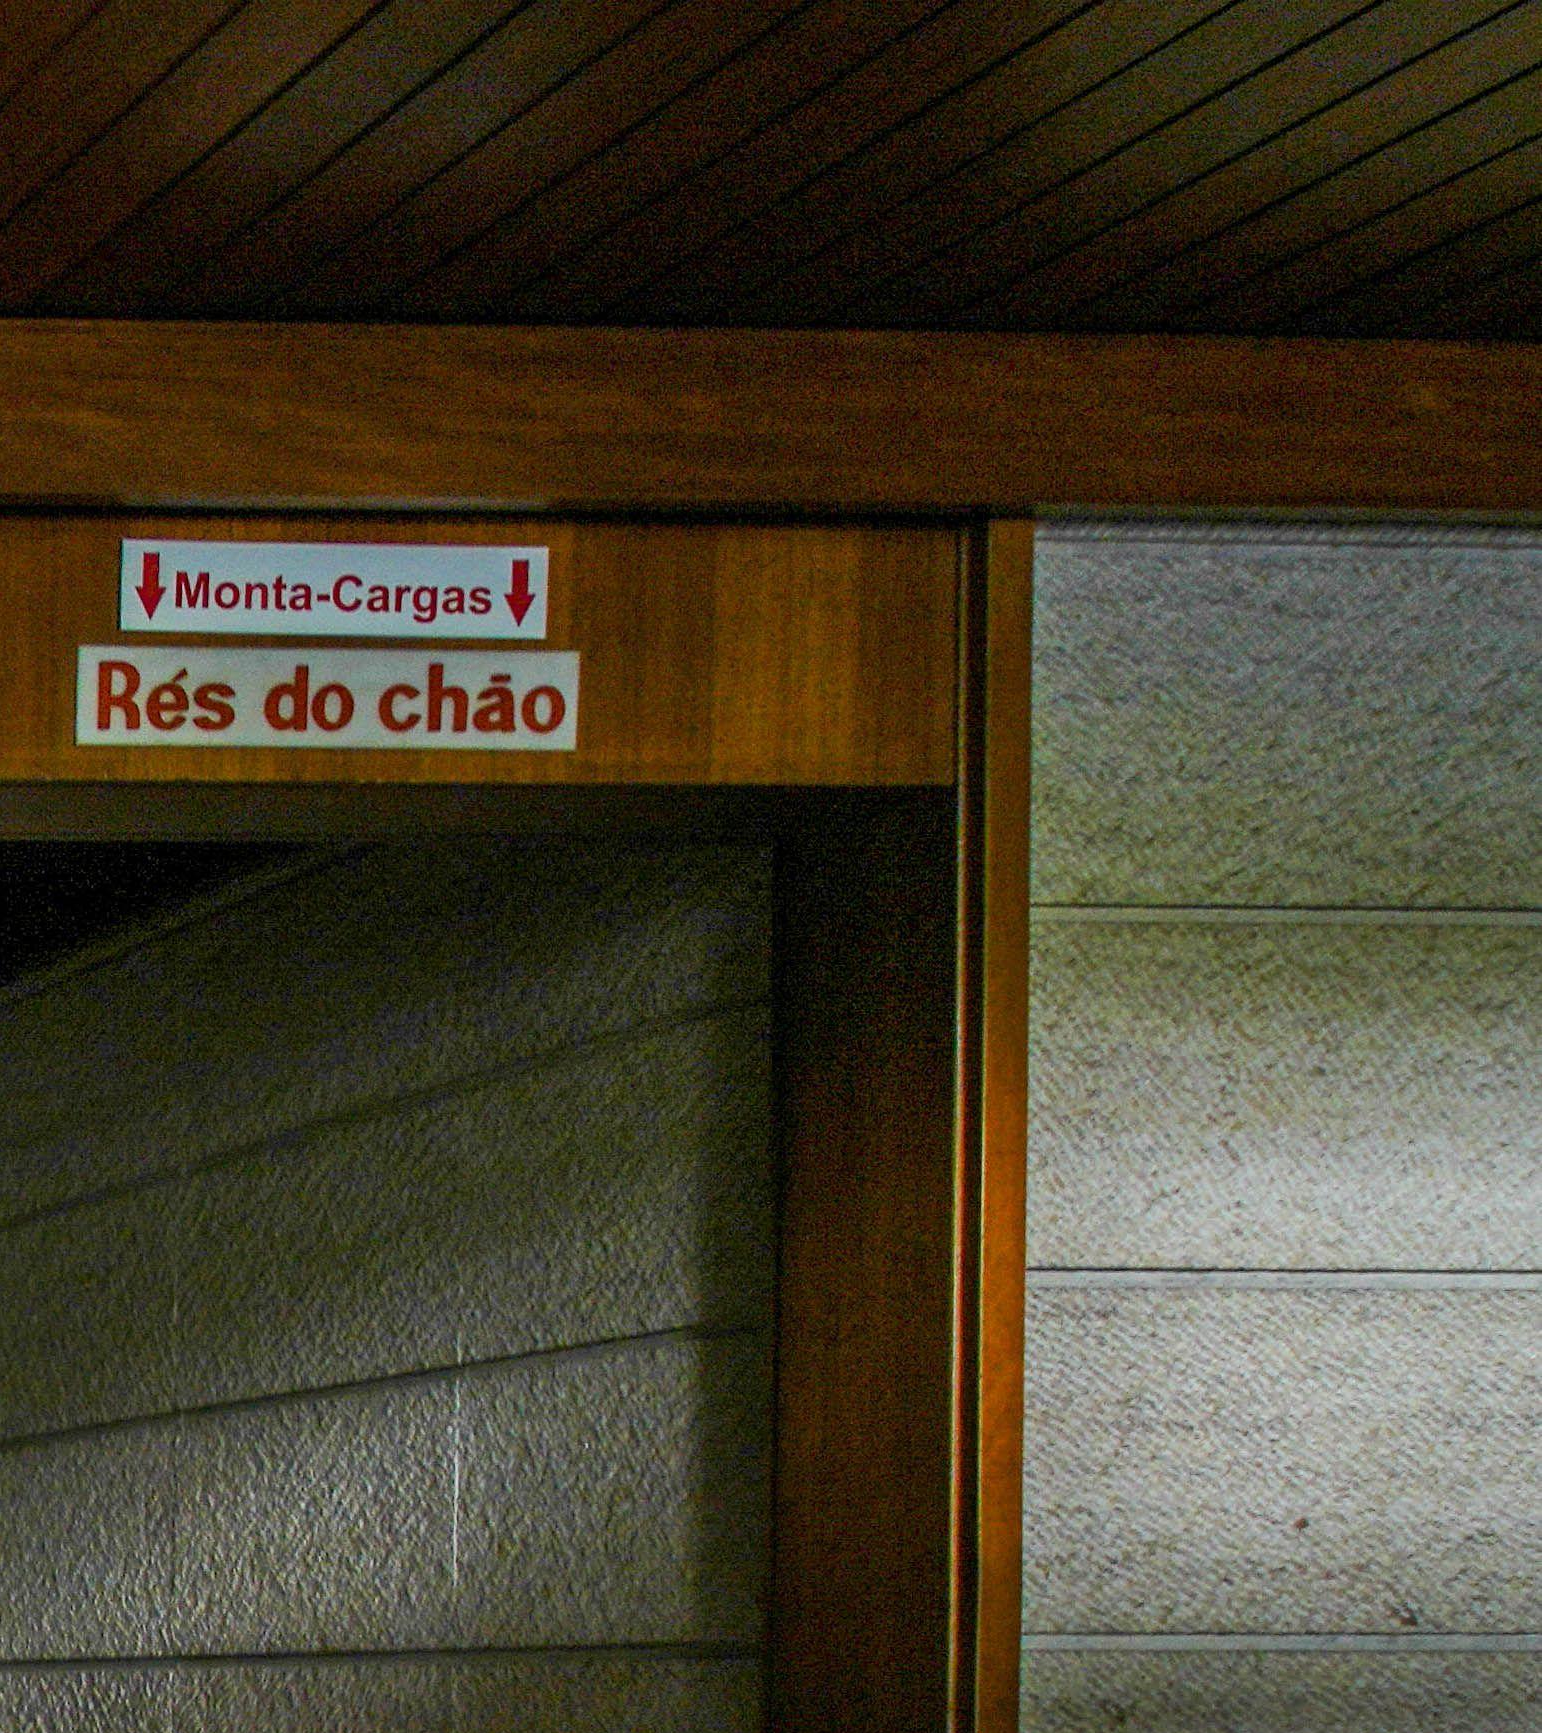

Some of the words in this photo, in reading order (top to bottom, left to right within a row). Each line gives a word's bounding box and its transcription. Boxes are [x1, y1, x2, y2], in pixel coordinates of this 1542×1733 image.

[174, 571, 493, 624] Monta-Cargas
[96, 660, 236, 732] Rés
[264, 664, 355, 732] do
[378, 663, 567, 734] chão
